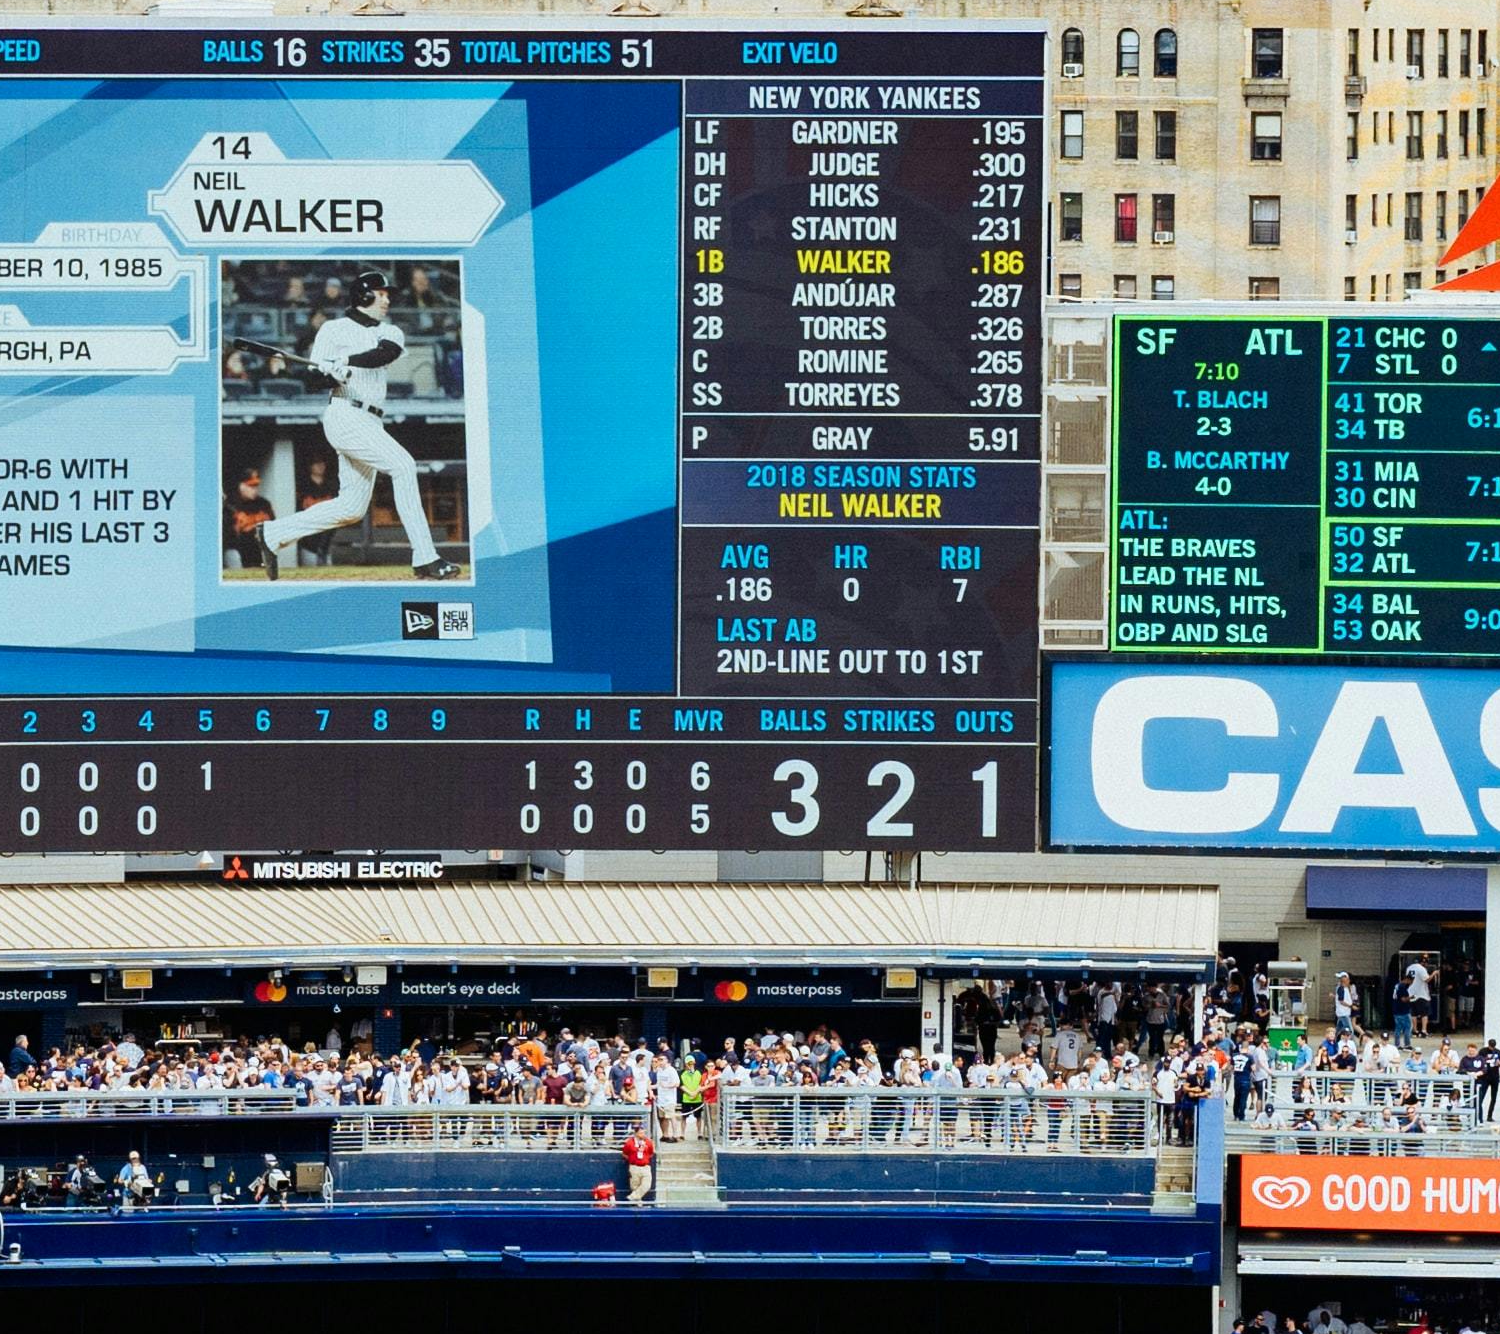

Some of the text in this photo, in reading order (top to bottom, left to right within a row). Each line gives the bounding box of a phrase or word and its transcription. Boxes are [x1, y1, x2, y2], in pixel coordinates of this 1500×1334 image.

[750, 87, 981, 109] NEW YORK YANKEES
[792, 121, 898, 144] GARDNER
[809, 153, 879, 176] JUDGE
[193, 171, 245, 192] NEIL
[810, 184, 878, 207] HICKS
[193, 198, 384, 234] WALKER
[791, 217, 896, 240] STANTON
[52, 258, 91, 282] 10,
[99, 258, 163, 279] 1985
[797, 250, 891, 273] WALKER
[792, 279, 895, 306] ANDÚJAR
[800, 316, 886, 340] TORRES
[61, 342, 91, 361] PA
[798, 350, 887, 373] ROMINE
[785, 382, 900, 406] TORREYES
[812, 427, 872, 449] GRAY
[761, 709, 1014, 733] BALLS STRIKES OUTS
[253, 861, 443, 879] MITSUBISHI ELECTRIC
[401, 980, 520, 998] batter's eye deck
